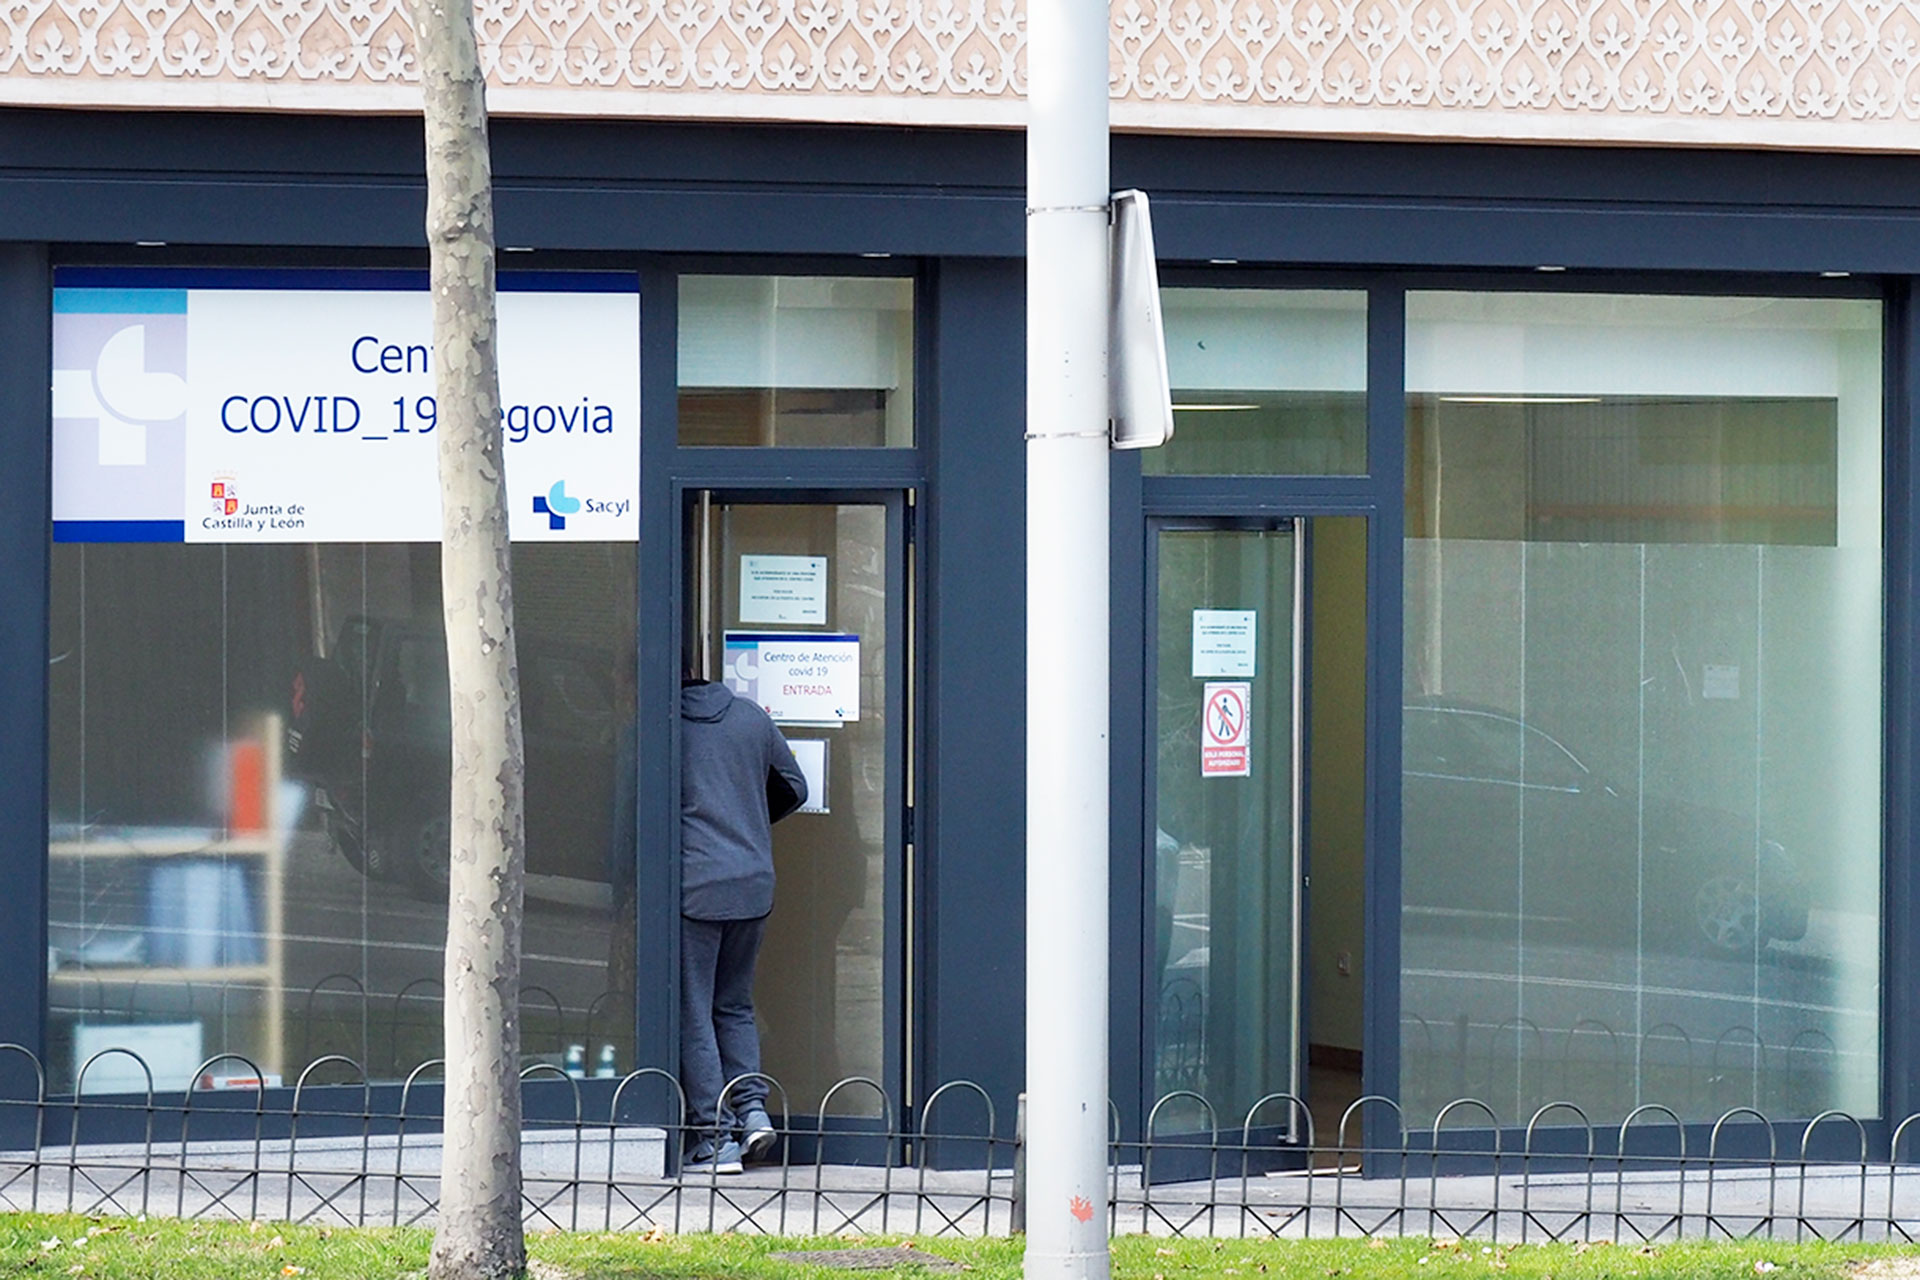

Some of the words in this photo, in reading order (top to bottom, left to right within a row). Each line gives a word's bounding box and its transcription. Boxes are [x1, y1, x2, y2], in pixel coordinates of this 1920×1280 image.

[352, 336, 434, 374] Cen
[221, 395, 438, 440] COVID_19
[499, 397, 614, 443] govia
[243, 504, 282, 515] Junta
[287, 504, 305, 515] de
[586, 498, 630, 517] Sacyl
[202, 517, 253, 529] Castilla
[257, 520, 266, 532] y
[270, 516, 305, 528] León
[764, 652, 796, 662] Centro
[797, 652, 810, 662] de
[812, 652, 853, 663] Atención
[788, 667, 813, 676] covid
[816, 666, 829, 676] 19
[783, 684, 832, 696] ENTRADA
